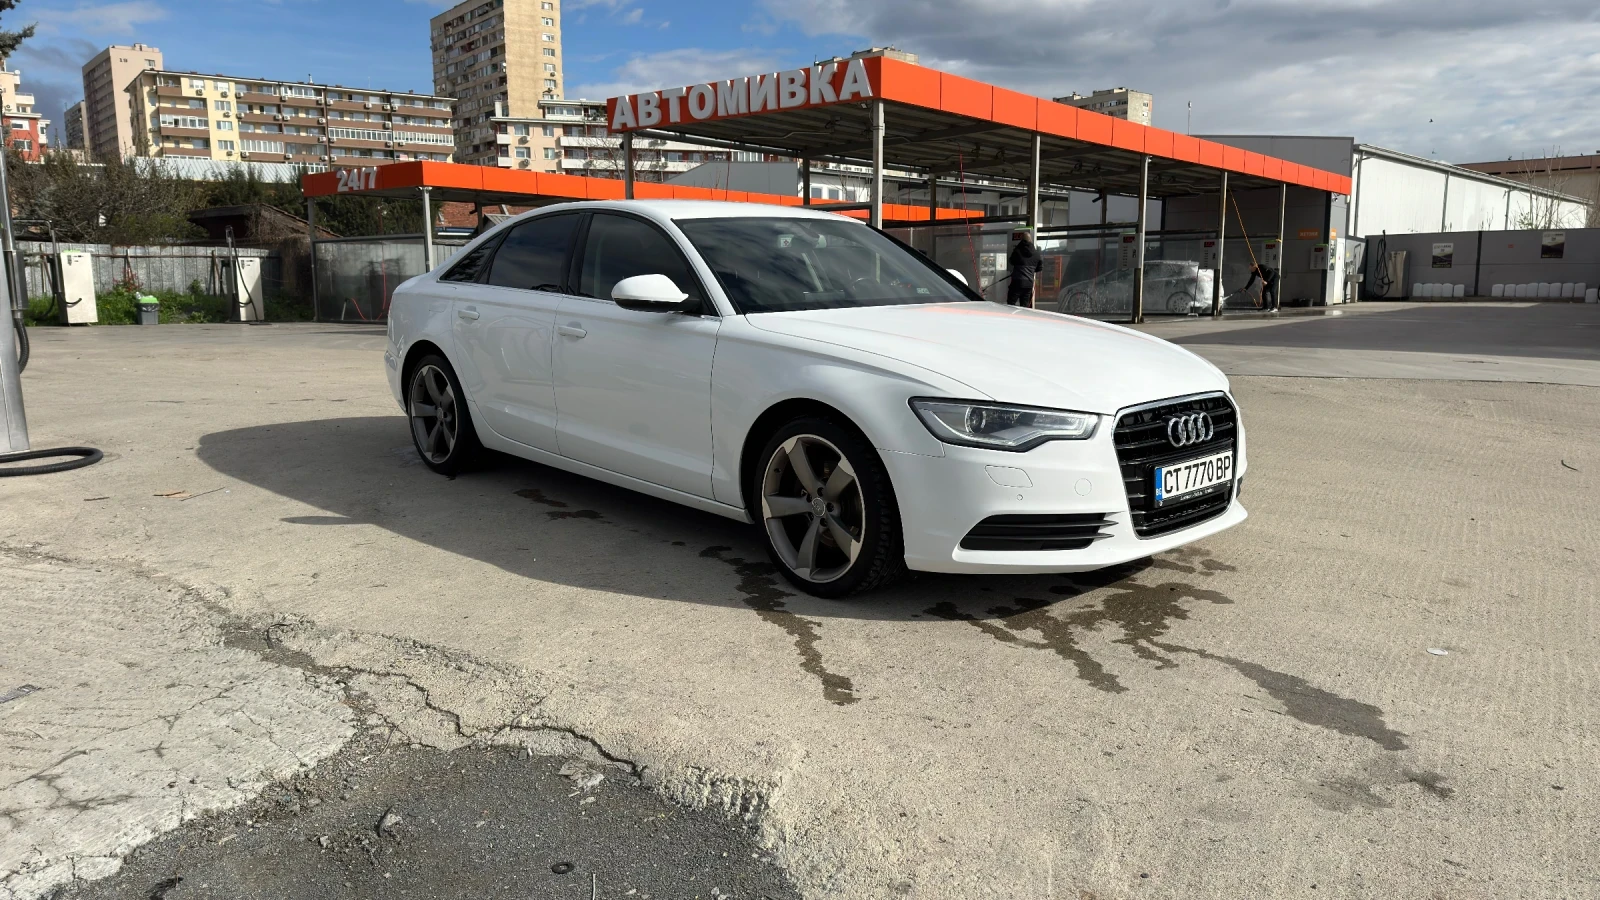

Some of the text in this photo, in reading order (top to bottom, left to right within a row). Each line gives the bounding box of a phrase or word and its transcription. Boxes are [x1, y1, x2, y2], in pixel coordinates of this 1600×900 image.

[611, 58, 874, 130] АВТОМИВКА
[336, 166, 378, 192] 24/7
[1164, 456, 1230, 494] CT 7770 BP
